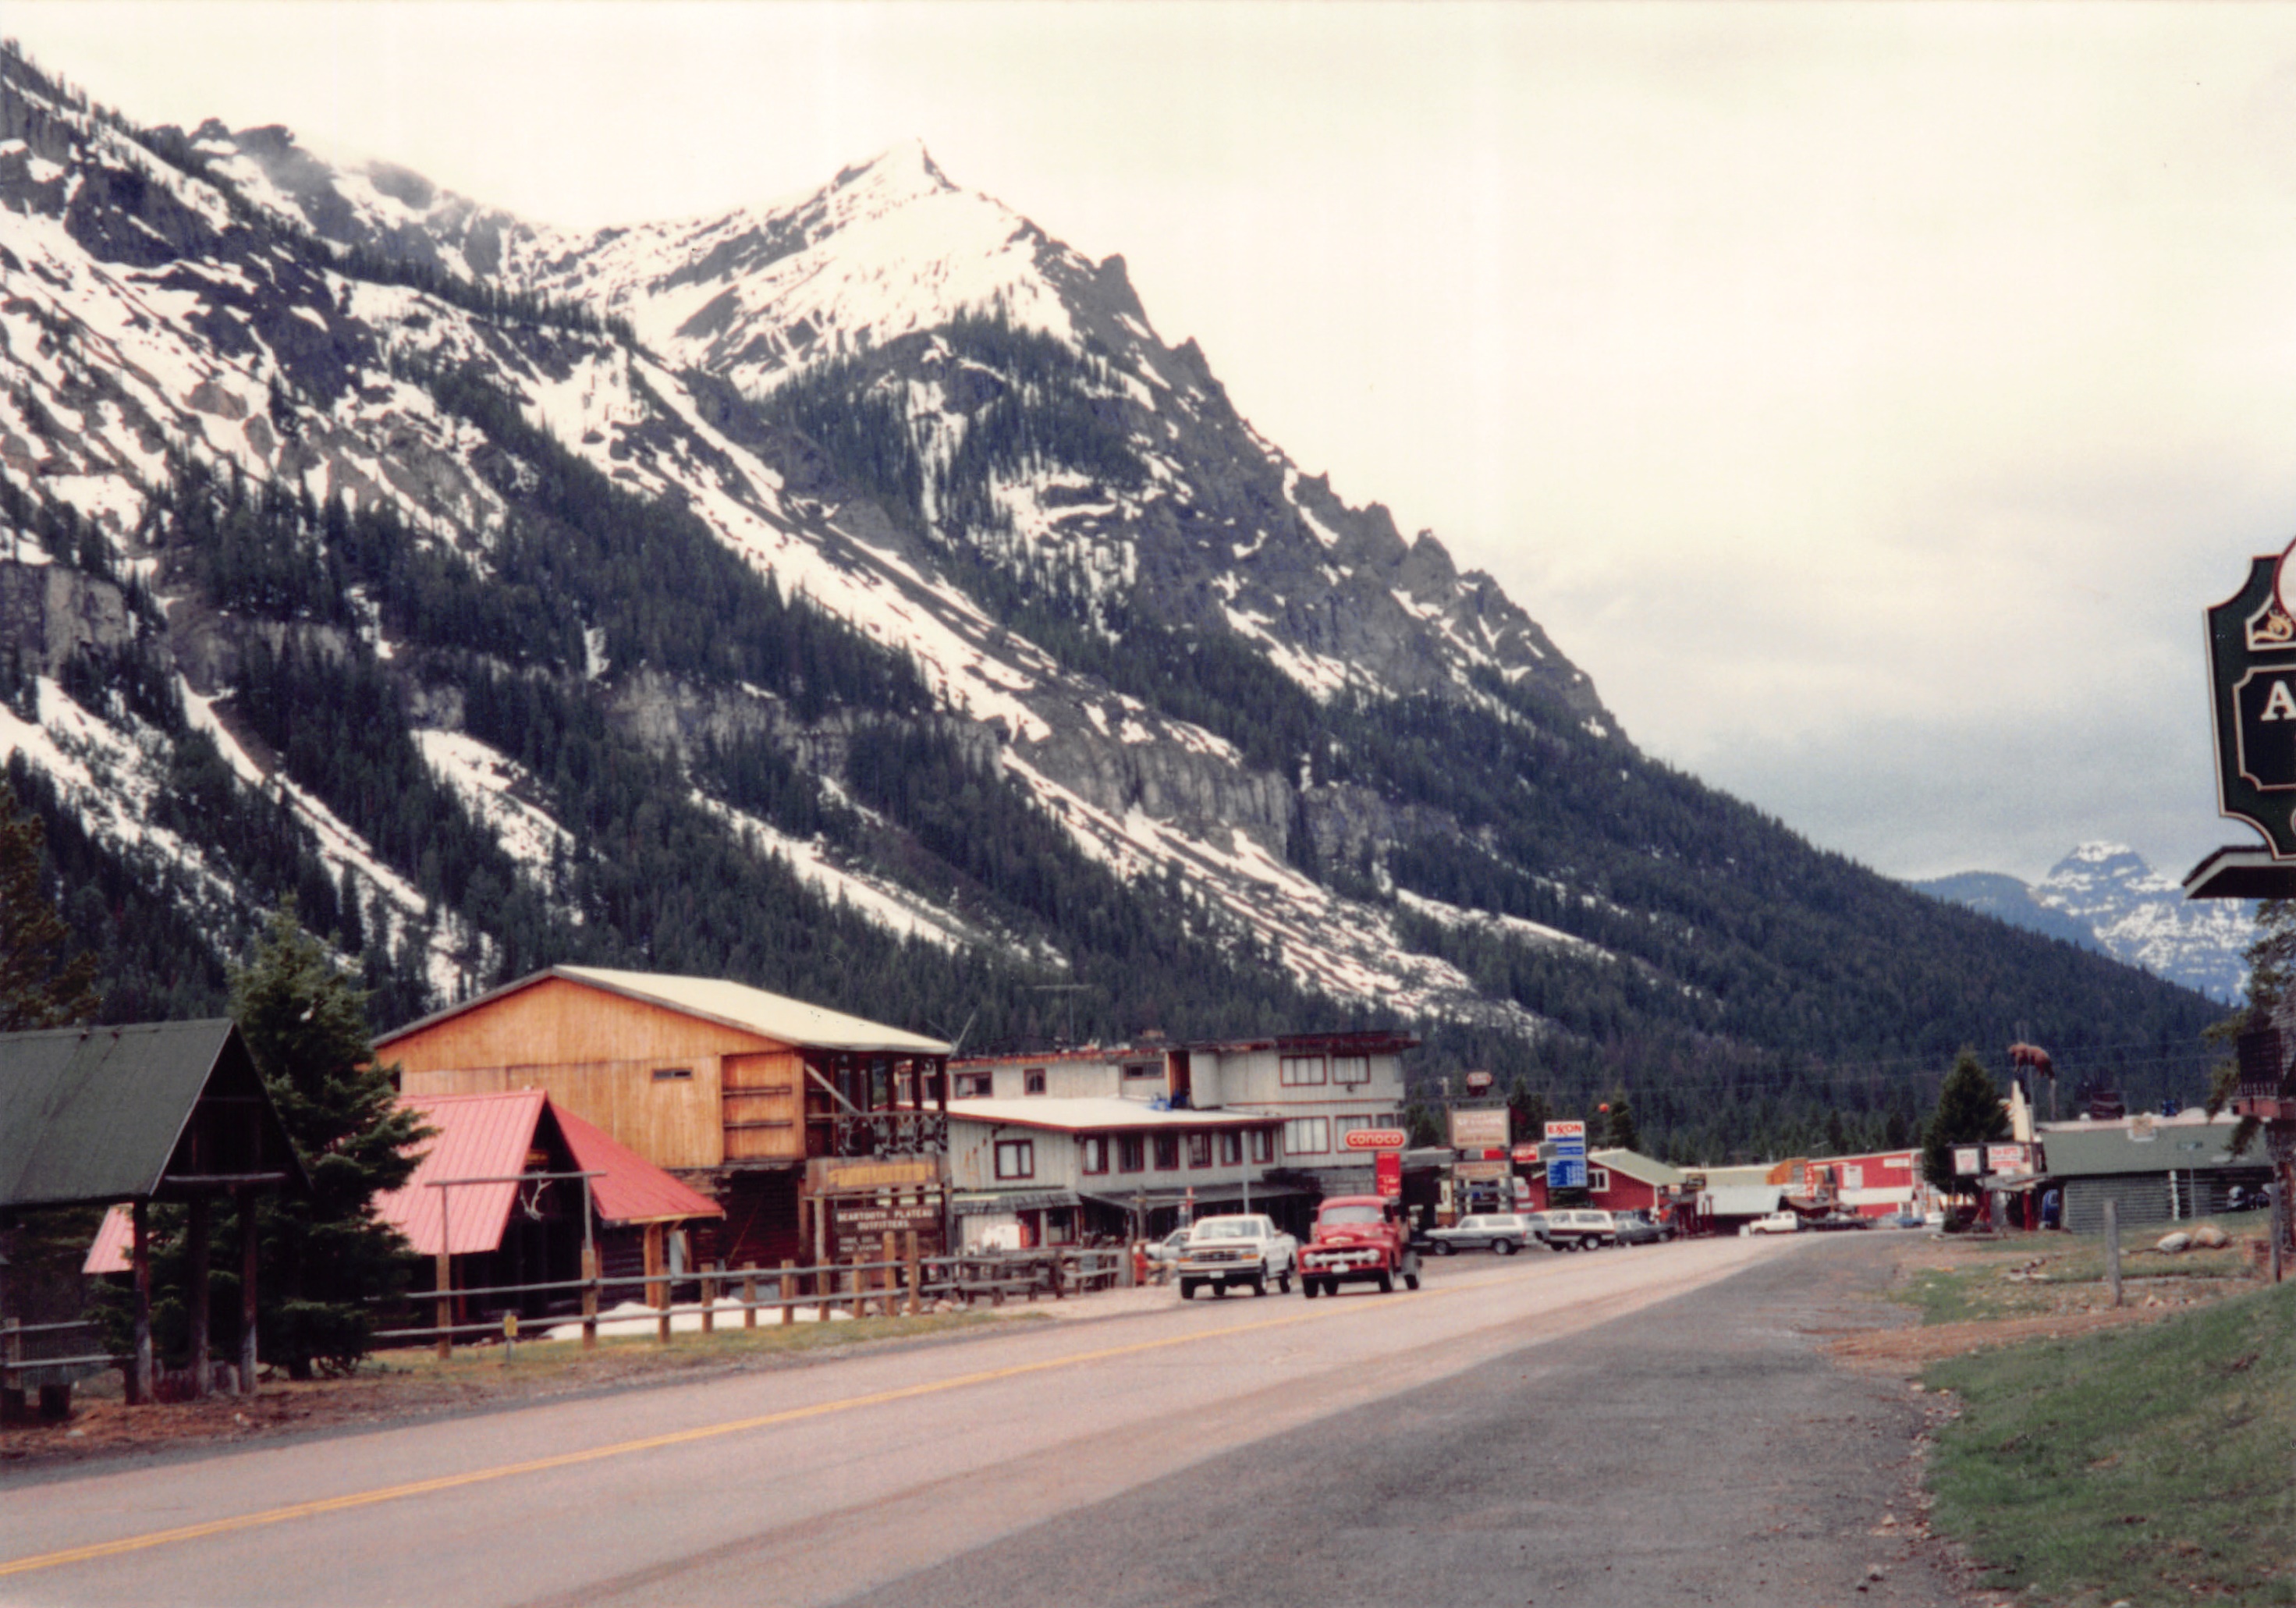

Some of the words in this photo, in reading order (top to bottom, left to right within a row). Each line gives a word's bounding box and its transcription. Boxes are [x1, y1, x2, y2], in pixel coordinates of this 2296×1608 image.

[1547, 1124, 1582, 1136] EXXON
[837, 1211, 887, 1223] BEARTOOTH
[893, 1209, 935, 1219] PLATEAU
[857, 1219, 910, 1230] OUTFITTERS
